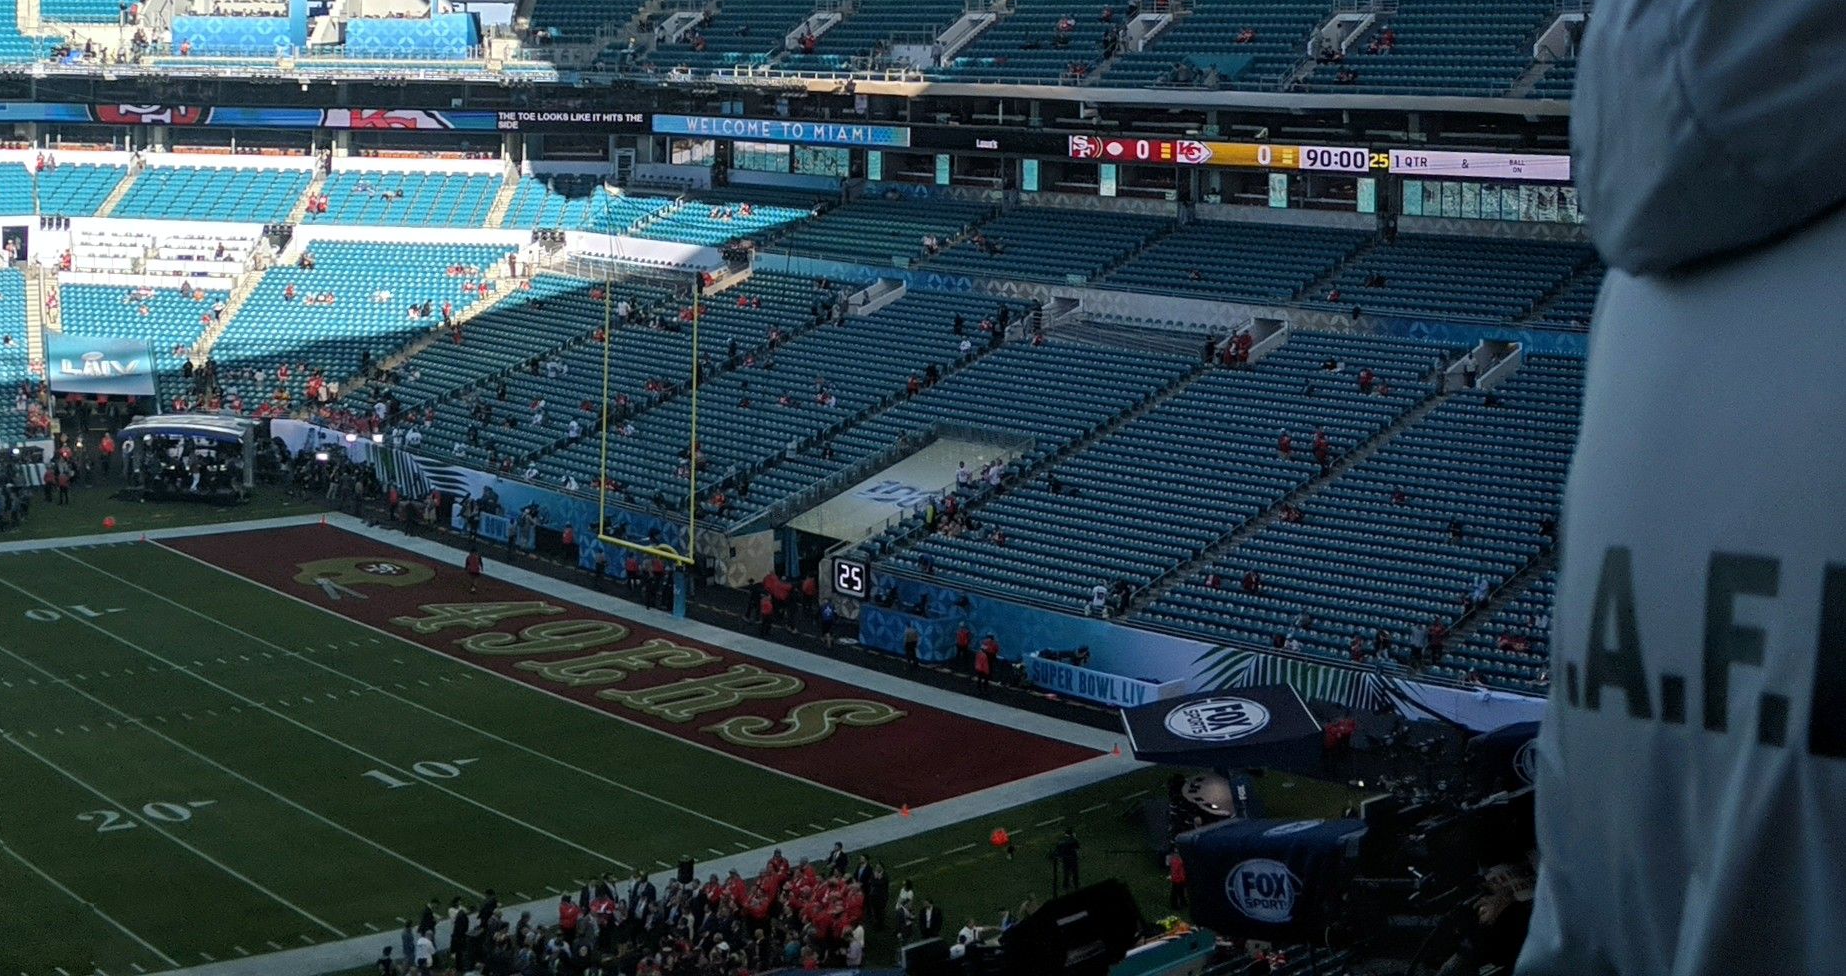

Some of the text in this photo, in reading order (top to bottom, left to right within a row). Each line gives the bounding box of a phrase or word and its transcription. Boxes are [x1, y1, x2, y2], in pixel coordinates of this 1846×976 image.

[686, 118, 873, 142] WELCOME TO MIAMI
[1136, 140, 1149, 159] 0
[1257, 145, 1271, 164] 0
[1306, 150, 1366, 169] 90:00
[1369, 154, 1389, 168] 25
[839, 564, 861, 591] 25
[391, 599, 908, 748] 49ERS
[1032, 661, 1146, 704] SUPER BOWL LIV
[1201, 703, 1253, 732] FOX
[363, 760, 463, 790] 10
[76, 800, 193, 833] 20
[1241, 871, 1287, 900] FOX
